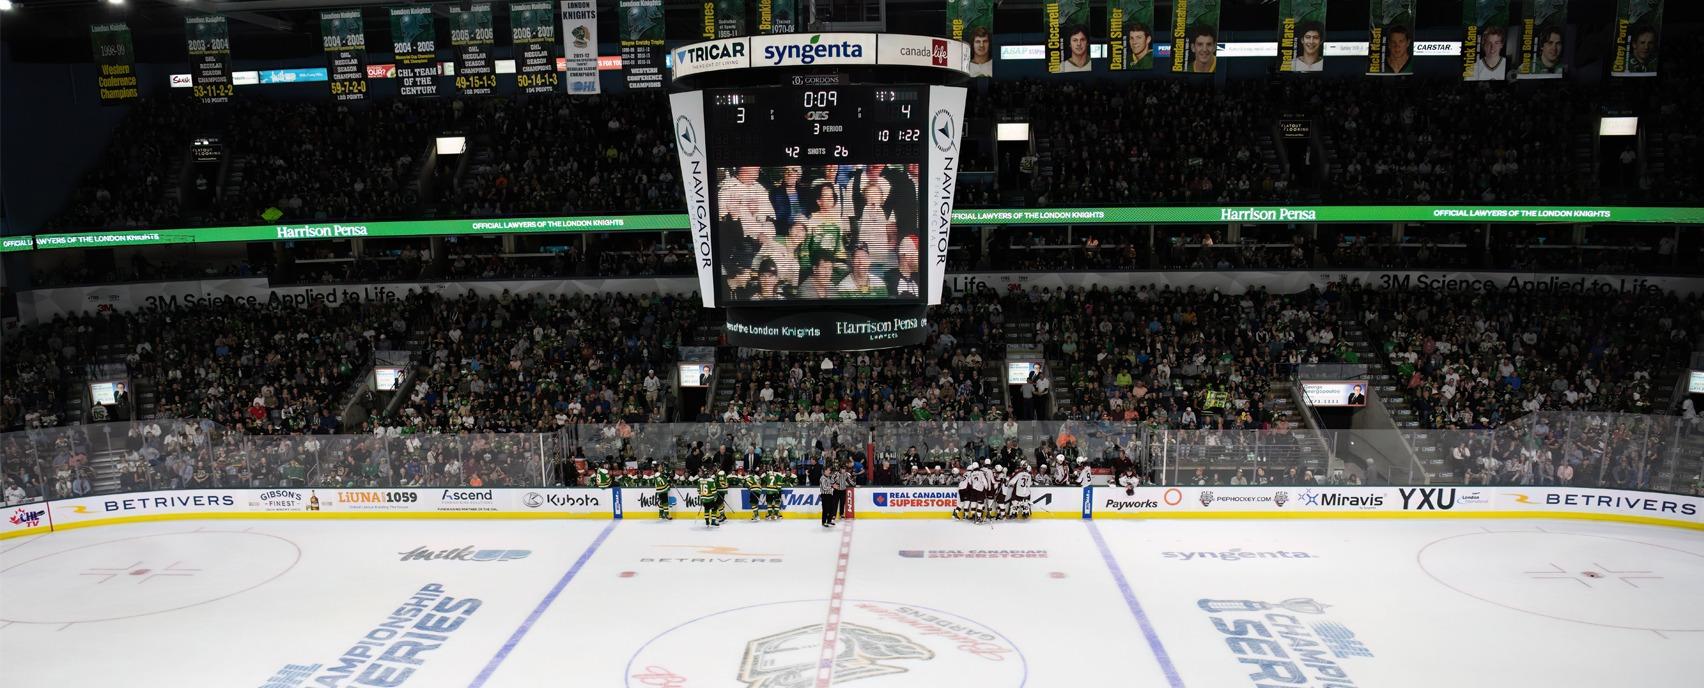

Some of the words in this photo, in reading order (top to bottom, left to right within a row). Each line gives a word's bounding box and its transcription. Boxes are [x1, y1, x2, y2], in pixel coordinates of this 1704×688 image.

[562, 11, 596, 20] KNIGHTS
[703, 2, 715, 39] James
[1110, 7, 1124, 39] Sittler
[452, 31, 469, 42] 2005
[476, 29, 494, 40] 2006
[513, 28, 531, 39] 2006
[537, 27, 554, 38] 2007
[1282, 17, 1298, 47] Marsh
[1465, 25, 1479, 46] Kane
[1522, 18, 1536, 52] Bolland
[1616, 18, 1631, 47] Perry
[188, 40, 206, 50] 2003
[212, 39, 229, 50] 2004
[323, 36, 341, 47] 2004
[347, 34, 364, 46] 2005
[394, 42, 412, 53] 2004
[417, 41, 435, 52] 2005
[688, 42, 745, 63] TRICAR
[765, 42, 863, 65] syngenta
[900, 46, 931, 57] canada
[933, 44, 948, 63] life
[1417, 44, 1451, 52] CARSTAR
[1049, 48, 1063, 73] Dino
[1110, 40, 1125, 71] Darryl
[1172, 38, 1187, 72] Brendan
[1613, 48, 1630, 73] Corey
[1369, 51, 1381, 74] Rick
[1462, 46, 1478, 79] Patrick
[102, 64, 130, 76] Western
[398, 68, 413, 77] CHL
[415, 67, 437, 76] TEAM
[461, 67, 491, 75] CHAMPIONS
[522, 66, 552, 74] CHAMPIONS
[98, 76, 137, 88] Conference
[403, 78, 413, 86] OF
[416, 76, 432, 85] THE
[456, 76, 497, 90] 49-15-1-3
[517, 74, 558, 88] 50-14-1-3
[627, 75, 664, 83] CONFERENCE
[100, 87, 138, 99] Champions
[193, 85, 233, 98] 53-11-2-2
[331, 81, 366, 95] 59-7-2-0
[401, 85, 437, 96] CENTURY
[804, 91, 838, 108] 0:09
[736, 107, 745, 124] 3
[901, 104, 911, 119] 4
[813, 123, 820, 135] 3
[822, 125, 843, 133] PERIOD
[878, 130, 889, 141] 10
[898, 129, 920, 141] 1:22
[785, 146, 800, 158] 42
[834, 145, 849, 157] 26
[691, 161, 712, 269] NAVIGATOR
[935, 157, 954, 268] NAVIGATOR
[1220, 208, 1276, 221] Harrison
[1278, 208, 1316, 221] Pensa
[1433, 209, 1469, 217] OFFICIAL
[1574, 210, 1610, 218] KNIGHTS
[276, 225, 332, 238] Harrison
[333, 224, 368, 236] Pensa
[3, 239, 28, 247] OFFICIAL
[1008, 283, 1022, 292] 3M
[1379, 274, 1410, 290] 3M
[1507, 276, 1585, 295] Applied
[1591, 279, 1613, 294] to
[145, 294, 177, 309] 3M
[269, 288, 337, 306] Applied
[342, 289, 360, 302] to
[365, 286, 400, 303] Life.
[97, 303, 113, 313] 3M
[749, 325, 779, 335] London
[782, 326, 821, 338] Knights
[836, 320, 893, 334] Harrison
[893, 318, 918, 331] Pensa
[260, 490, 302, 501] GIBSON'S
[442, 489, 493, 501] Ascend
[700, 483, 709, 495] 16
[104, 495, 234, 512] BETRIVERS
[386, 491, 418, 503] 1059
[547, 494, 599, 506] Kubota
[890, 499, 957, 508] SUPERSTORE
[1321, 492, 1384, 506] Miravis
[1397, 488, 1455, 510] YXU
[1105, 499, 1158, 511] Payworks
[1545, 493, 1695, 515] BETRIVERS
[20, 511, 40, 522] CHL
[1161, 549, 1312, 561] syngenta
[896, 605, 995, 642] GARDENS
[305, 582, 445, 688] AMPIONSHIP
[345, 596, 482, 688] ERIES
